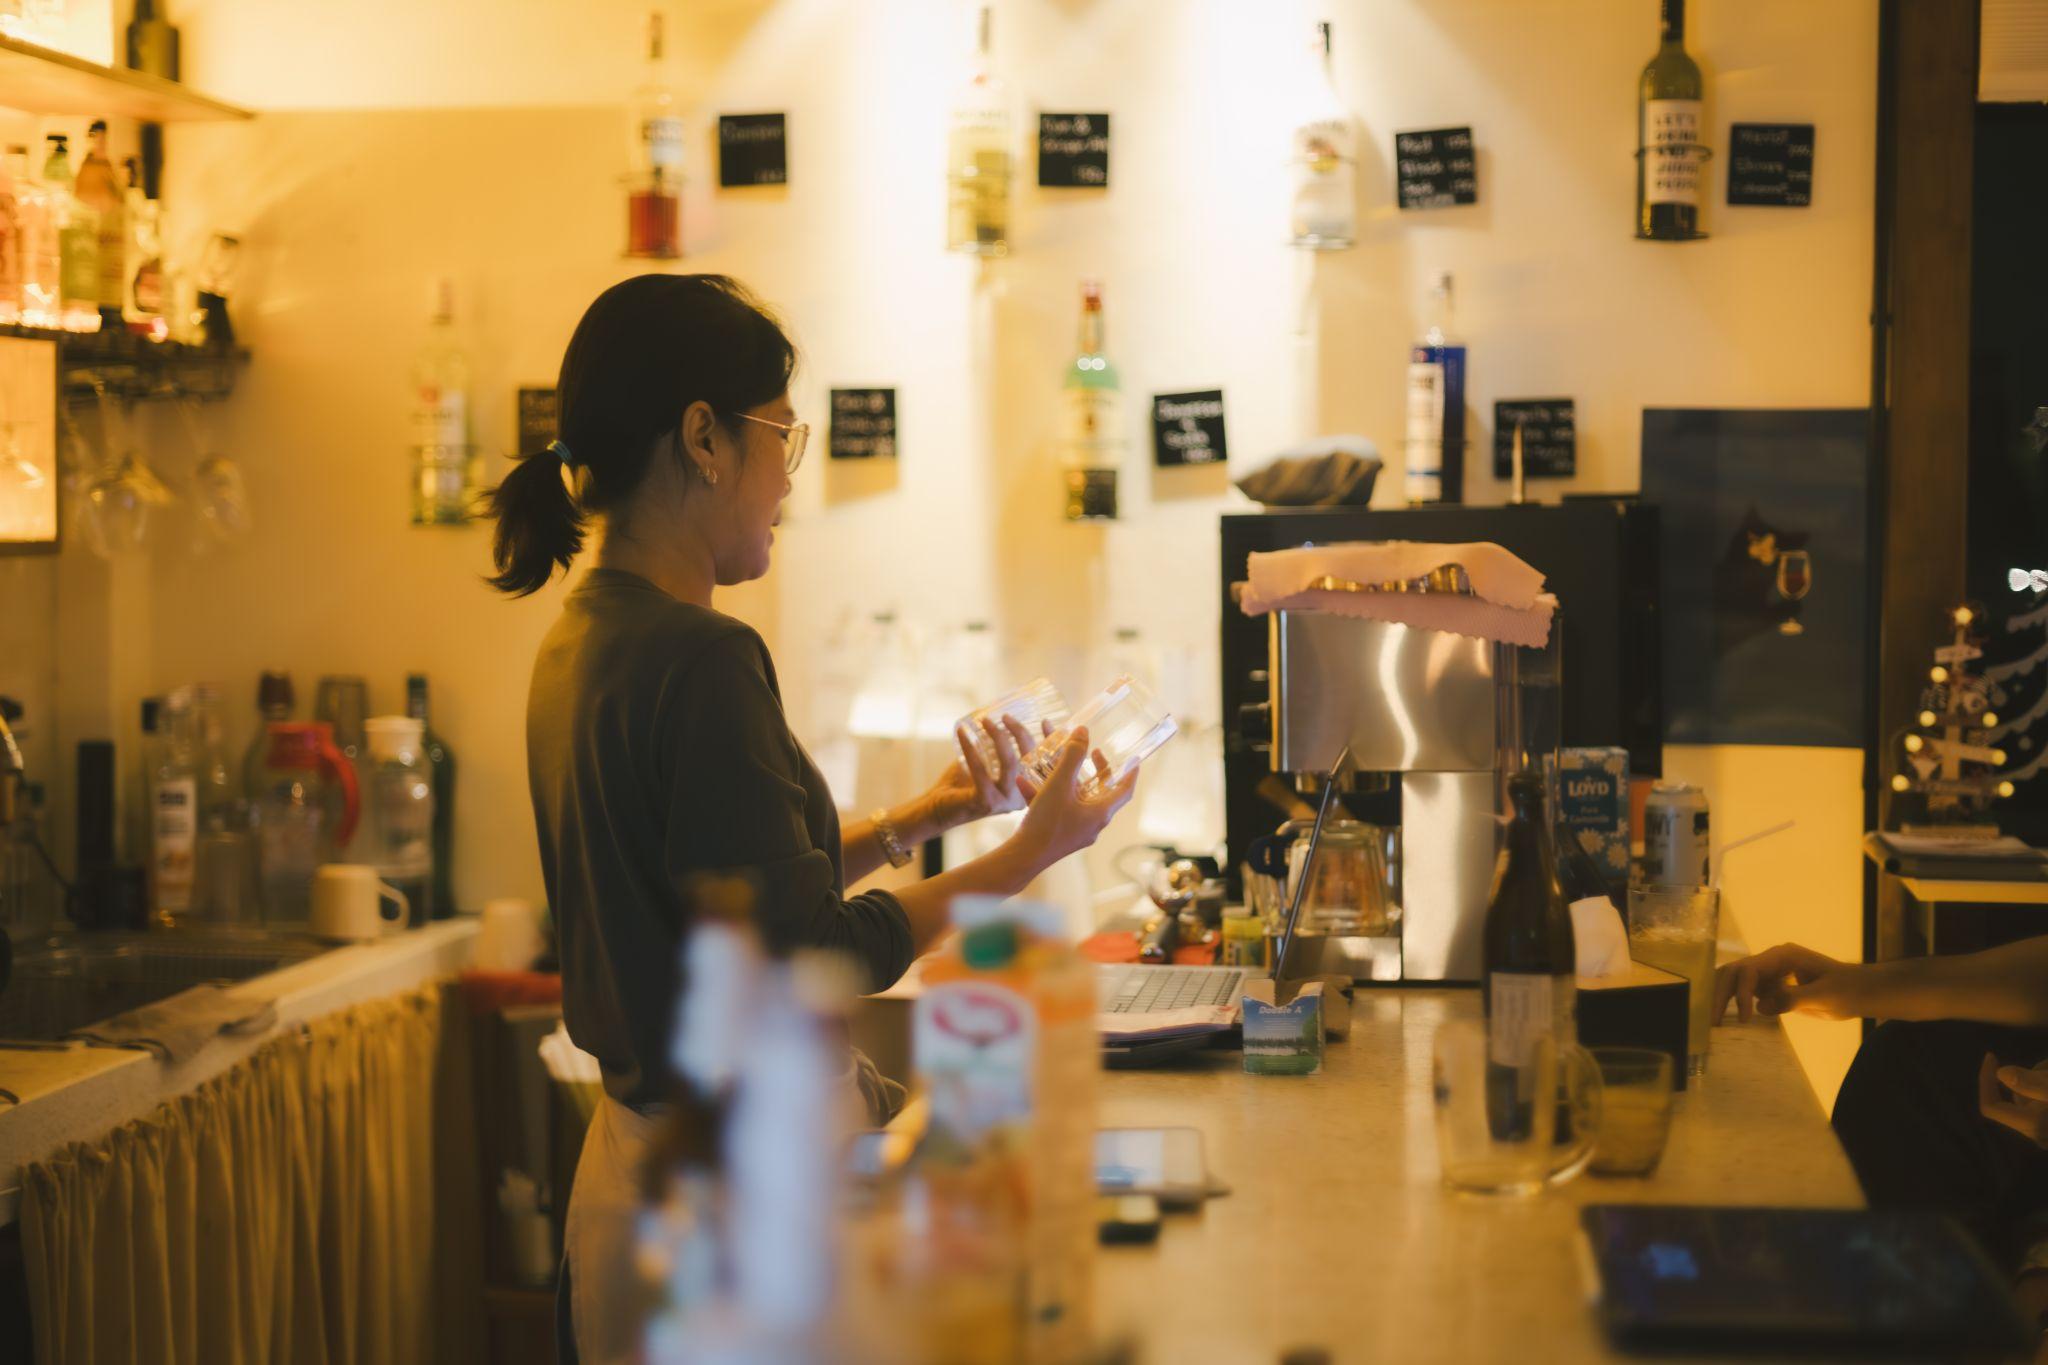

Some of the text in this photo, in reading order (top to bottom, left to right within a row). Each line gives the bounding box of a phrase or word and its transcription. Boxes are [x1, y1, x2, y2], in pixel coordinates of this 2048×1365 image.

[1568, 781, 1609, 797] LOYD
[1259, 1005, 1302, 1015] Double A
